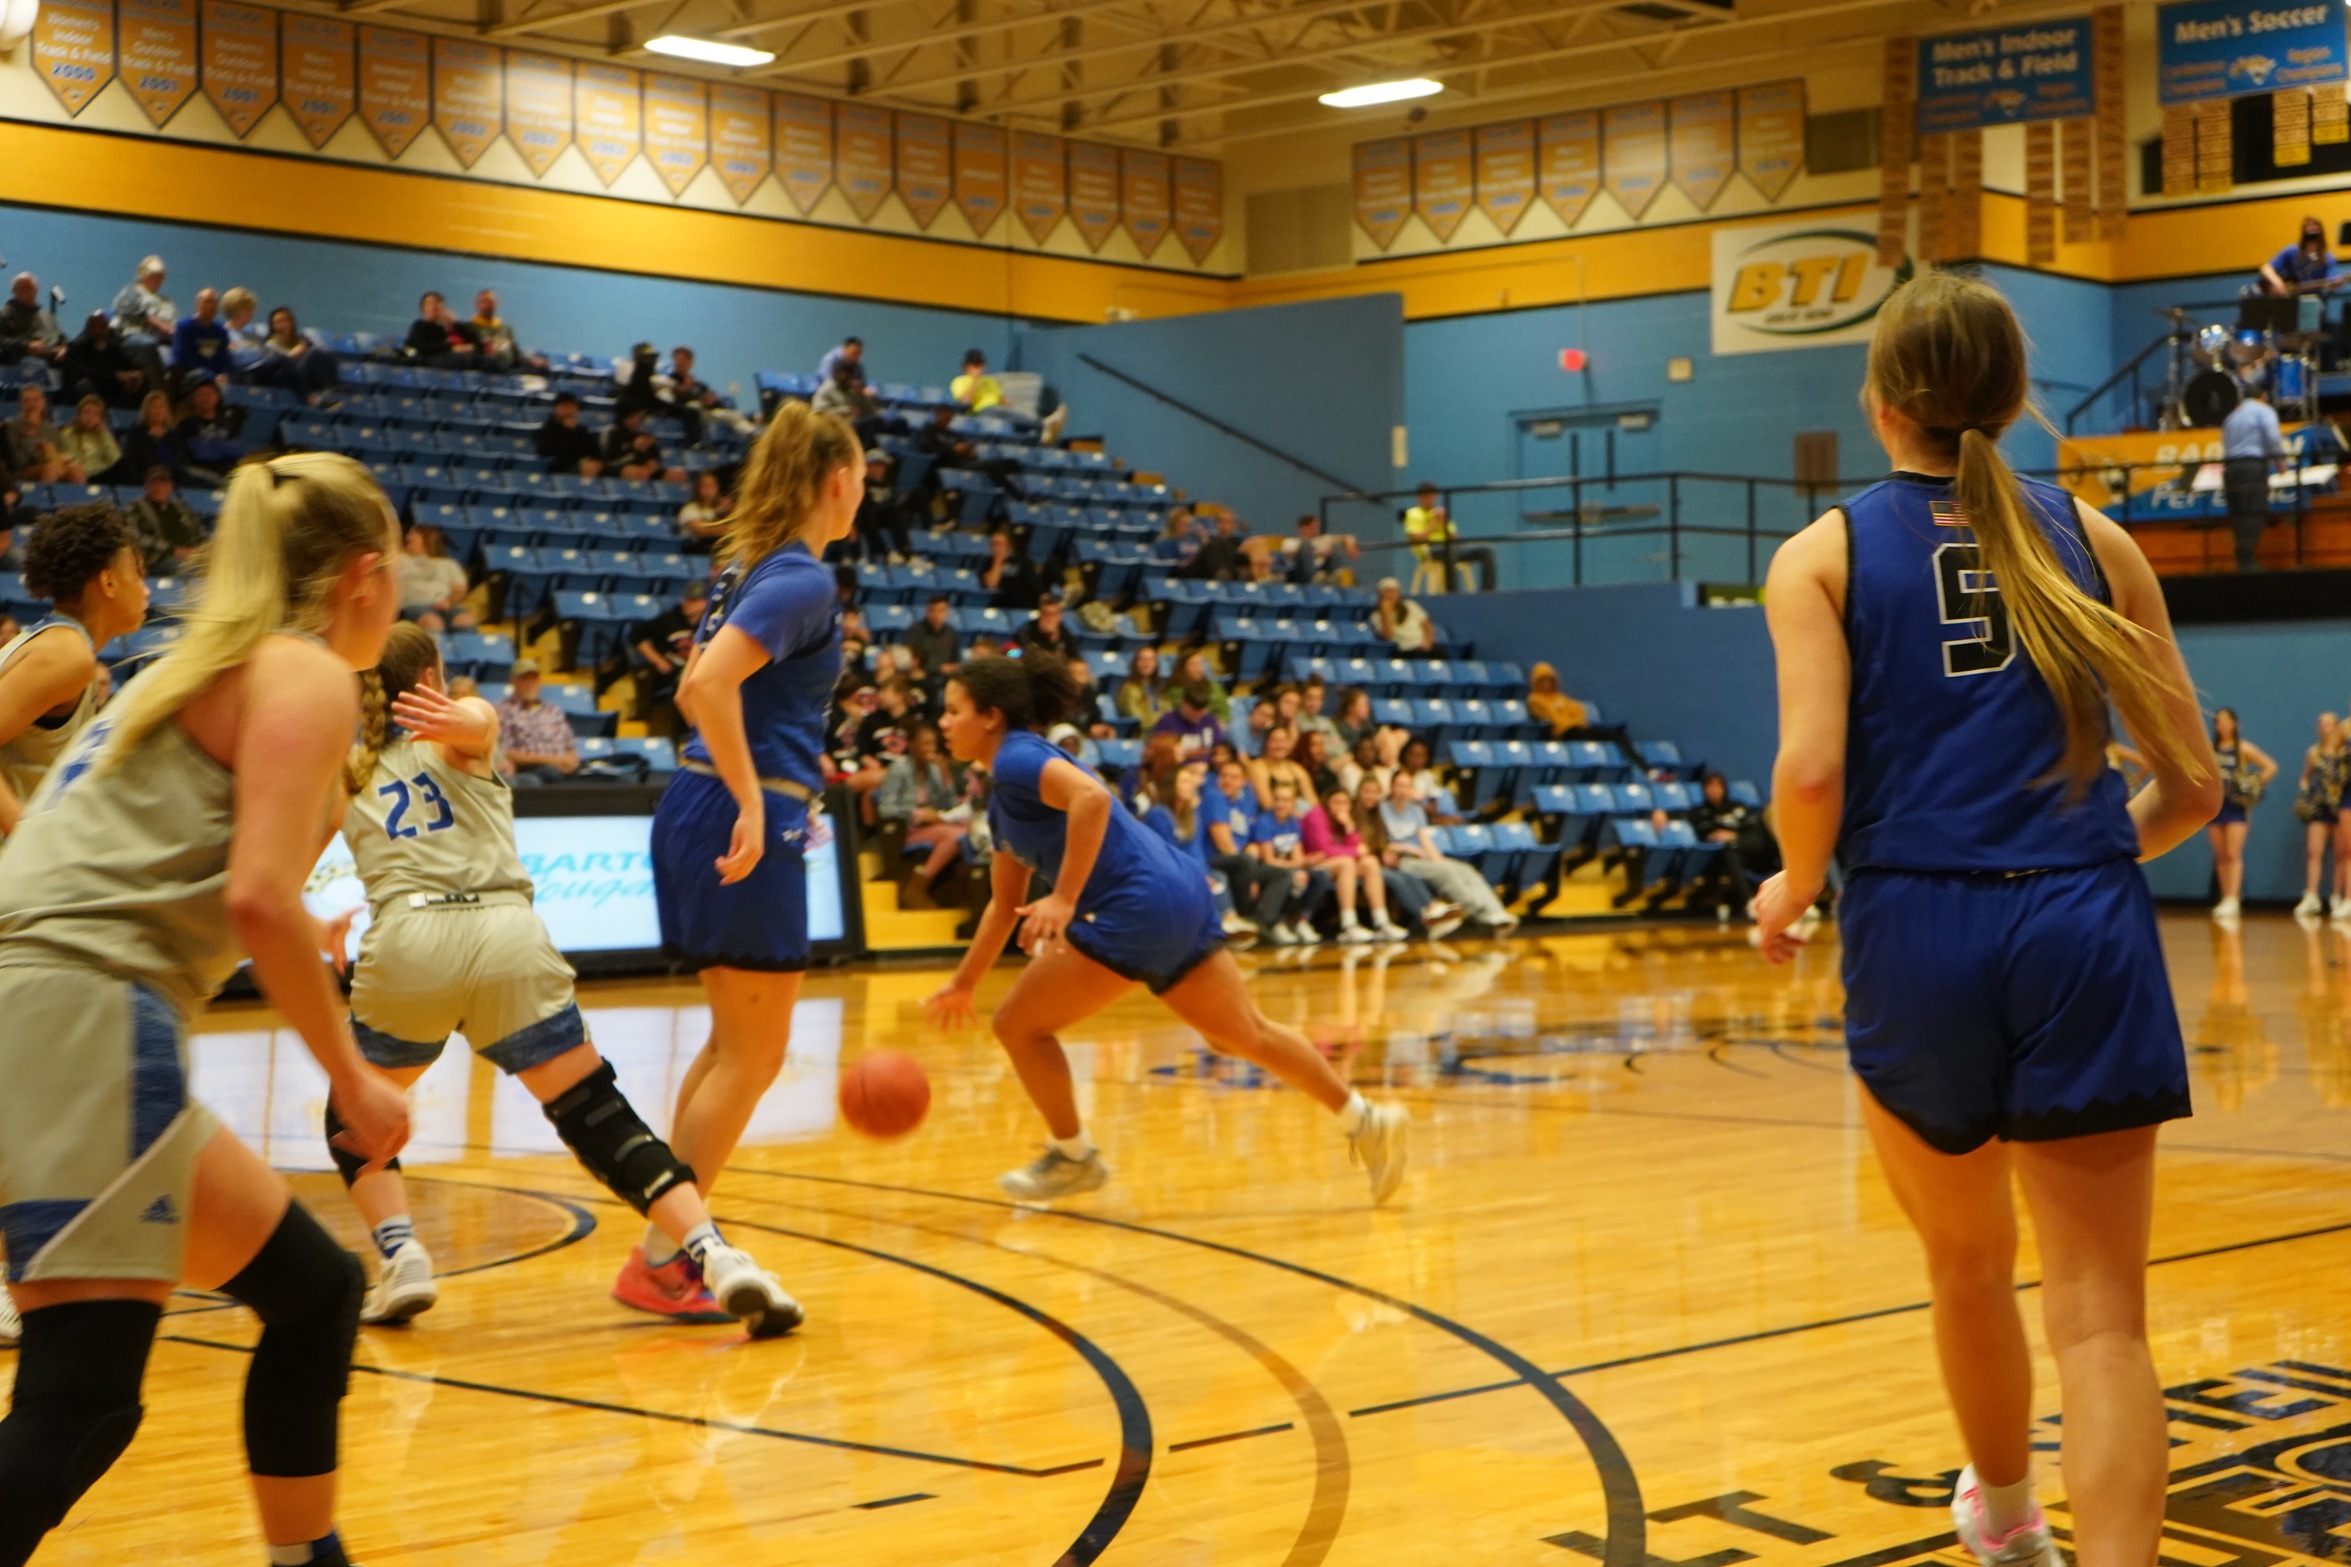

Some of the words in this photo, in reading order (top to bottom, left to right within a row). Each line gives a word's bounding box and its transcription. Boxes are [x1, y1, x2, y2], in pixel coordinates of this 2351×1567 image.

[2175, 14, 2244, 44] Men's
[2248, 4, 2329, 34] Soccer
[1932, 37, 1995, 63] Men's
[1999, 27, 2077, 54] Indoor
[1932, 61, 1994, 88] Track
[1996, 56, 2016, 80] &
[2019, 49, 2079, 77] Field
[1726, 251, 1869, 313] BTI
[378, 771, 455, 841] 23
